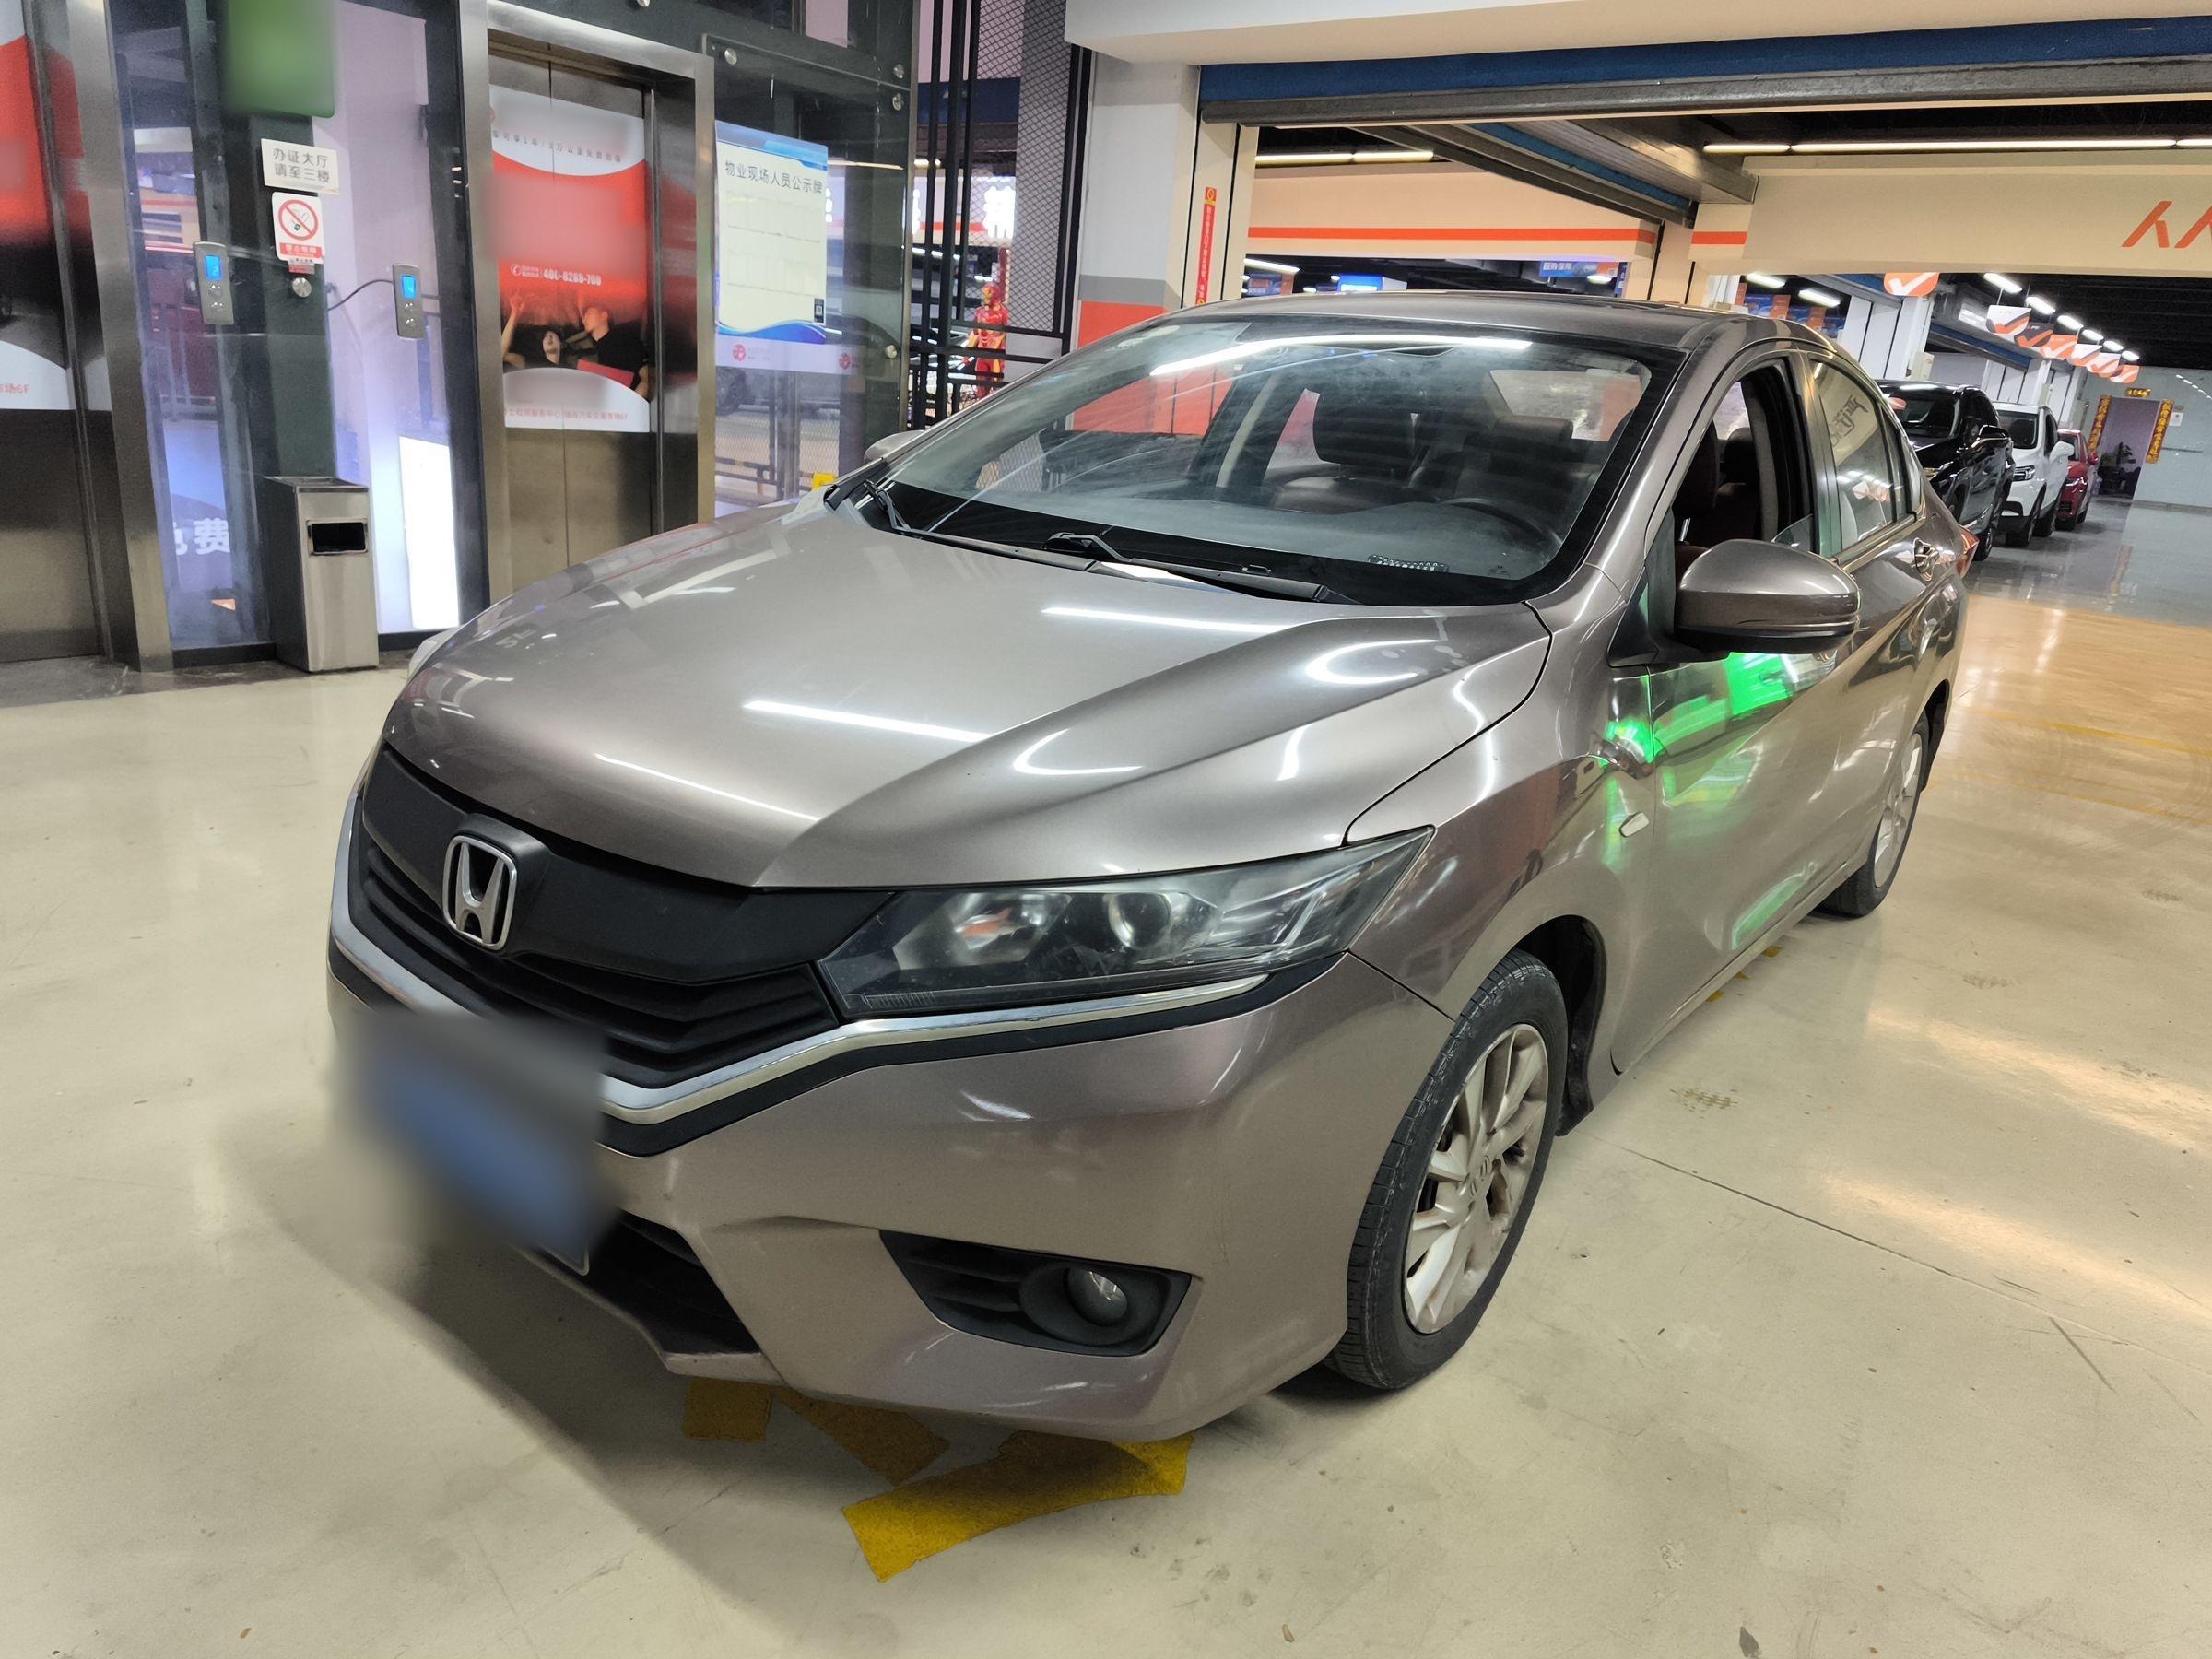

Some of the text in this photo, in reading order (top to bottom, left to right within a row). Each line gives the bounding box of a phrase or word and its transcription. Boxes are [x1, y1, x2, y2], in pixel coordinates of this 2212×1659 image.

[273, 147, 328, 168] 办证大厅
[275, 163, 330, 183] 请至三楼
[724, 160, 823, 194] 物业现场人员公示牌
